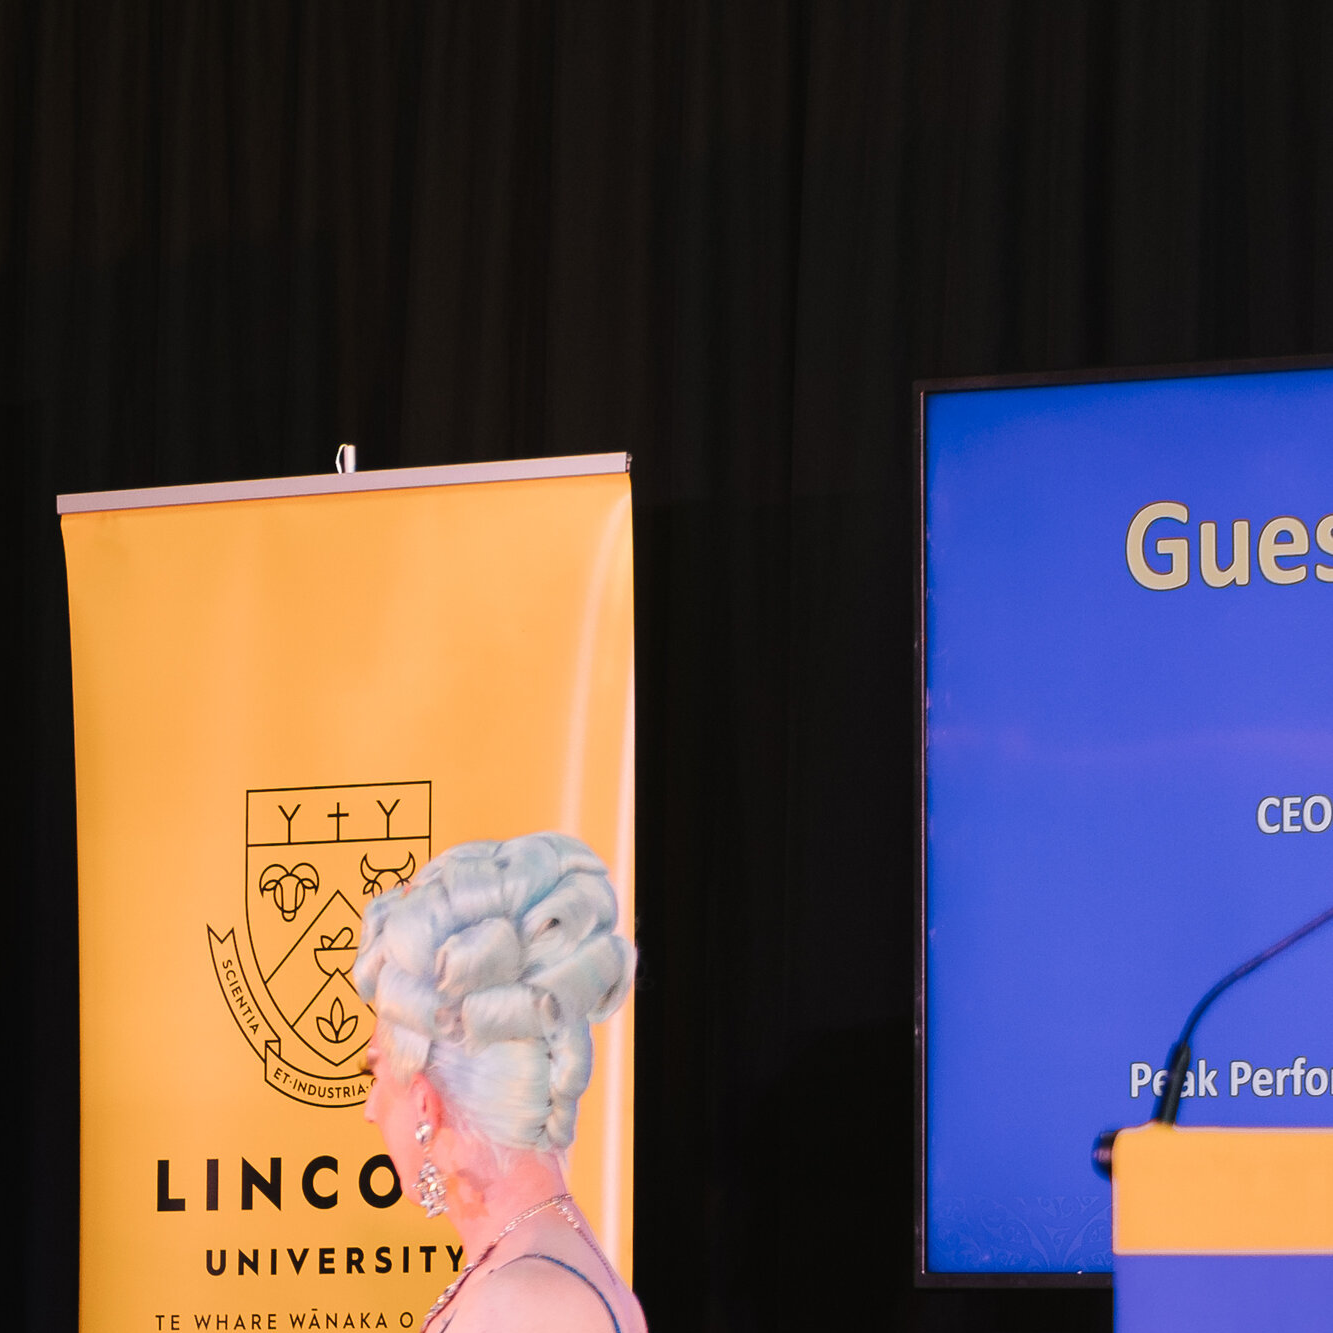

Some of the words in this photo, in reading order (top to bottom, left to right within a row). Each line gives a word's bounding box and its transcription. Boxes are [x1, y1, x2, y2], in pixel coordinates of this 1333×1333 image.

[1256, 794, 1333, 835] CEO
[222, 959, 260, 1035] SCIENTIA
[1230, 1056, 1333, 1097] Perfo
[157, 1155, 403, 1212] LINCO
[206, 1246, 464, 1276] UNIVERSITY
[155, 1314, 180, 1331] TE
[194, 1313, 277, 1331] WHARE
[289, 1308, 388, 1330] WĀNAKA
